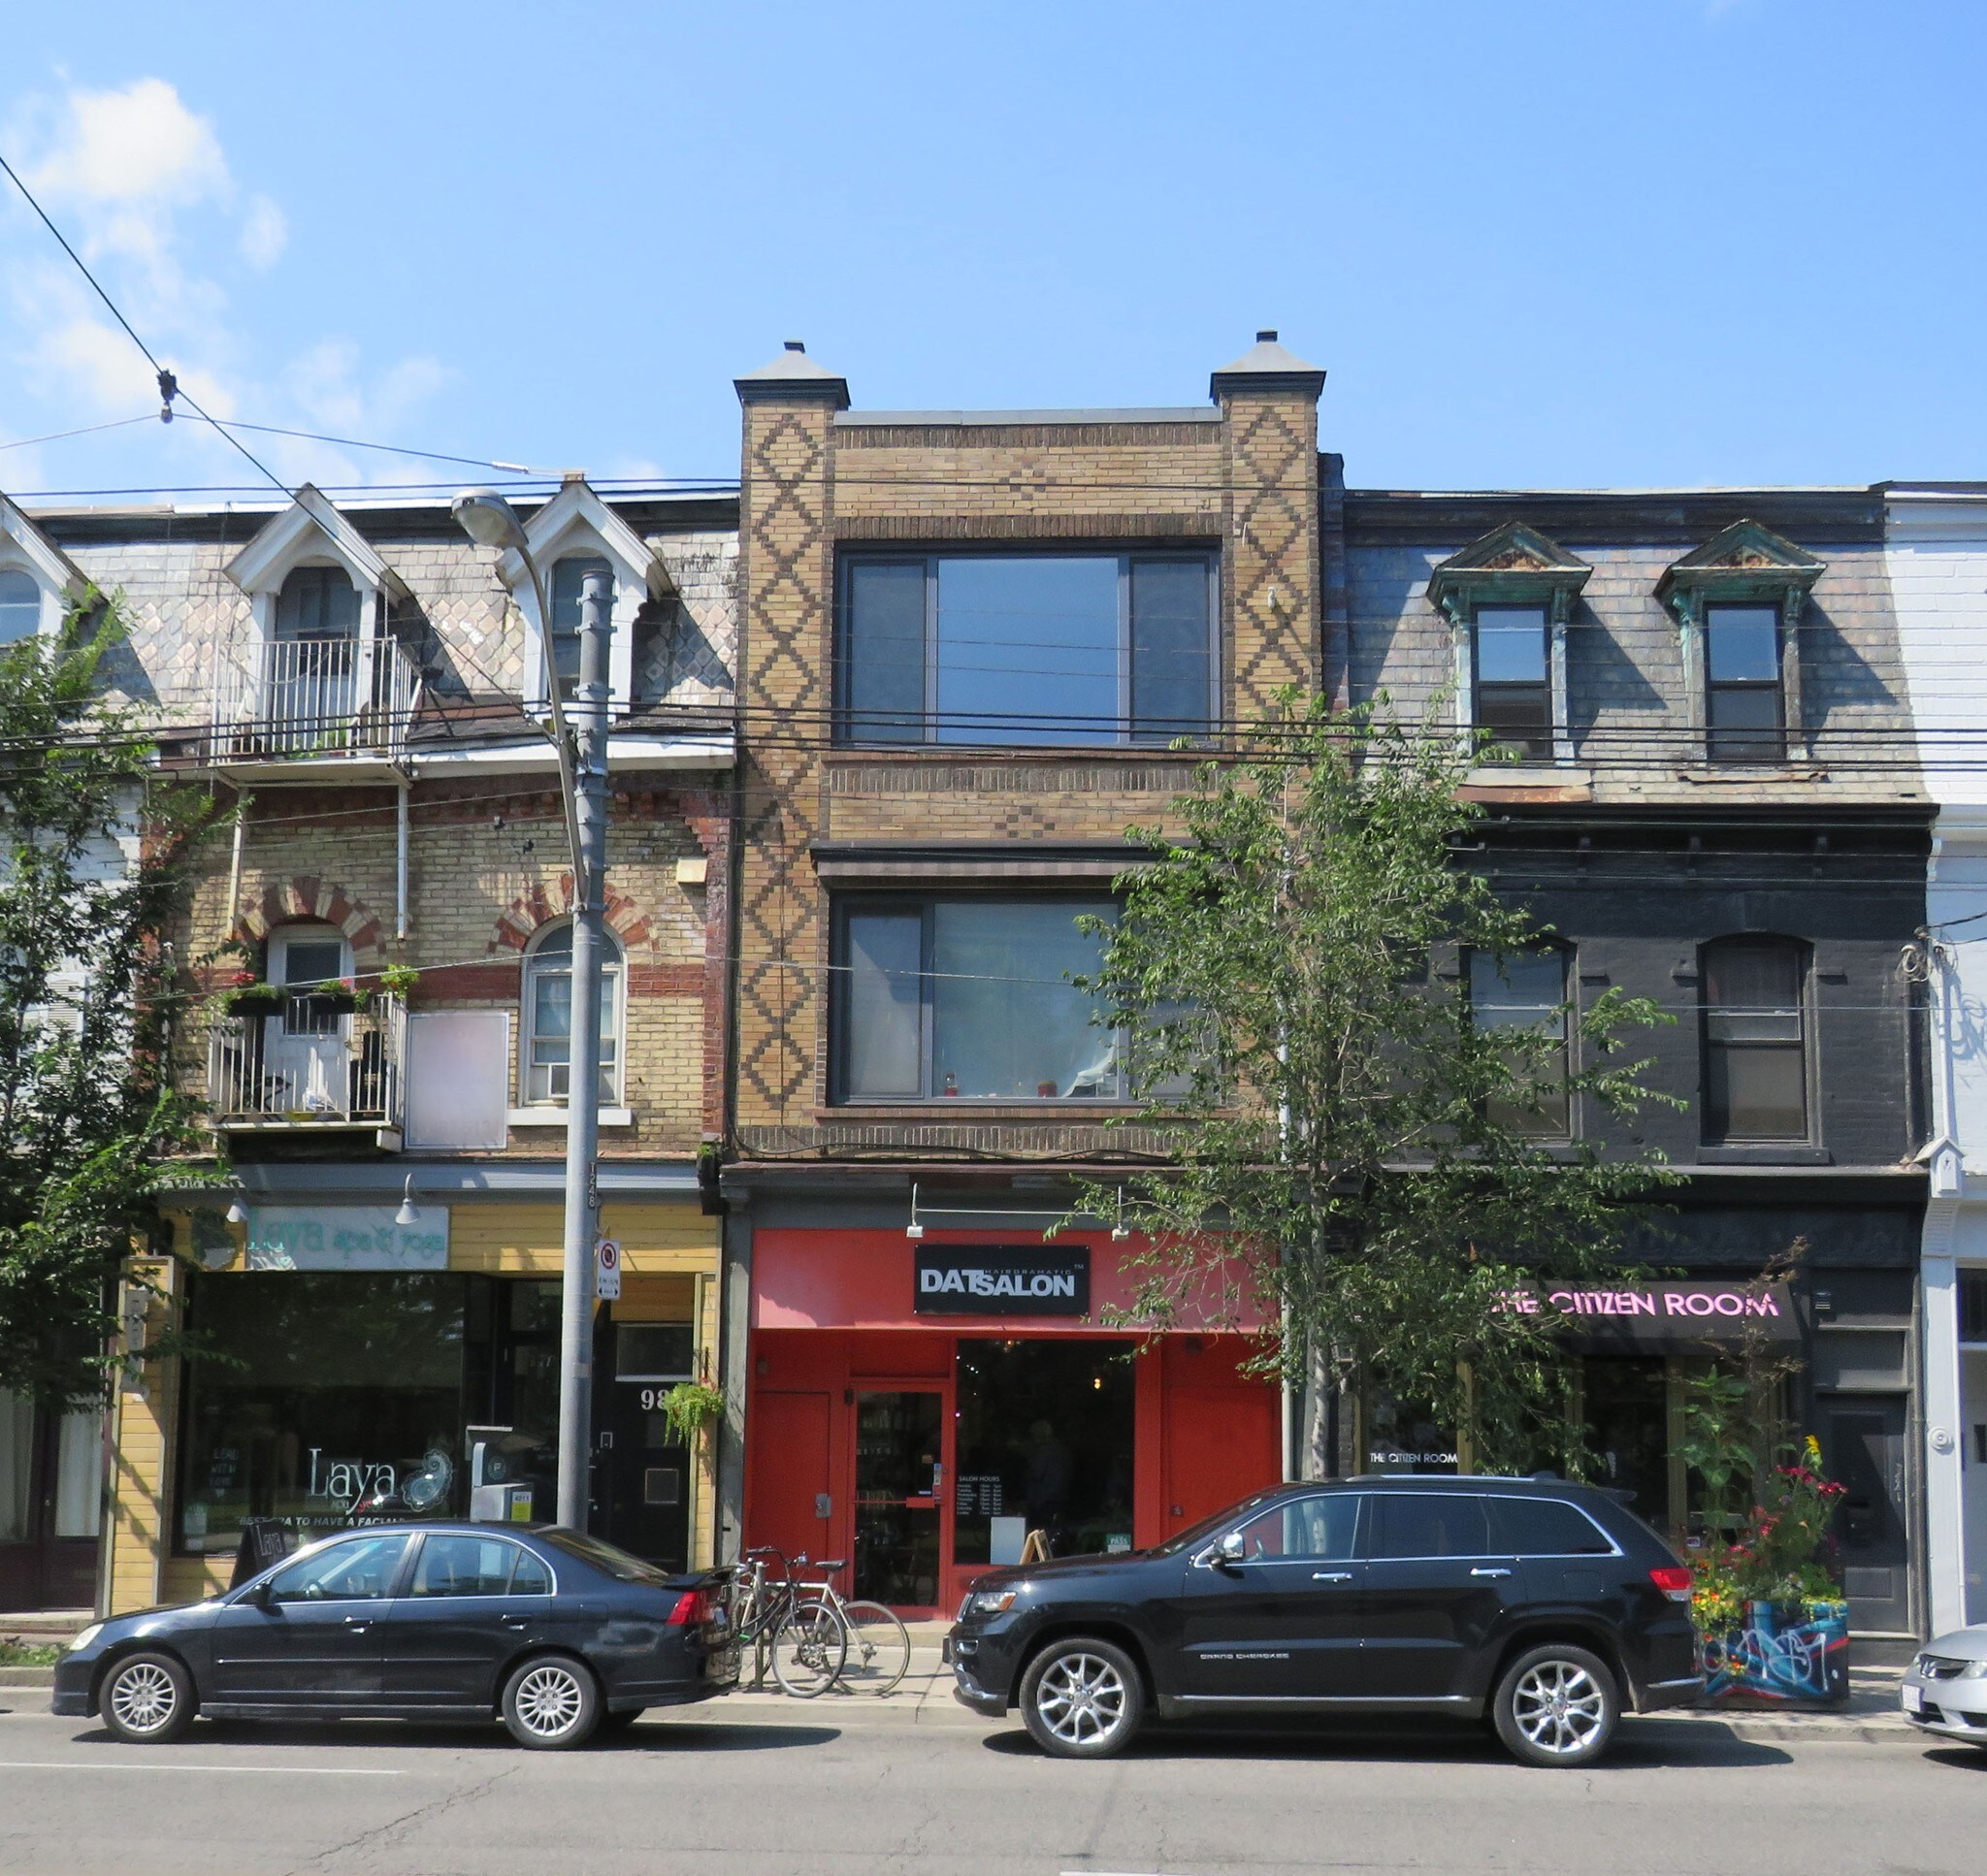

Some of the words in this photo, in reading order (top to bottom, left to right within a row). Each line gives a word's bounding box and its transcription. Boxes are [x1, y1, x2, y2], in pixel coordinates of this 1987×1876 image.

[401, 1232, 444, 1259] yoga
[1548, 1291, 1656, 1316] CITIZEN
[1664, 1292, 1779, 1317] ROOM
[1369, 1452, 1385, 1463] THE
[1388, 1452, 1421, 1463] CITIZEN
[1423, 1452, 1458, 1463] ROOM
[309, 1448, 398, 1515] Laya
[295, 1516, 311, 1526] TO
[313, 1516, 343, 1527] HAVE
[346, 1517, 355, 1526] A
